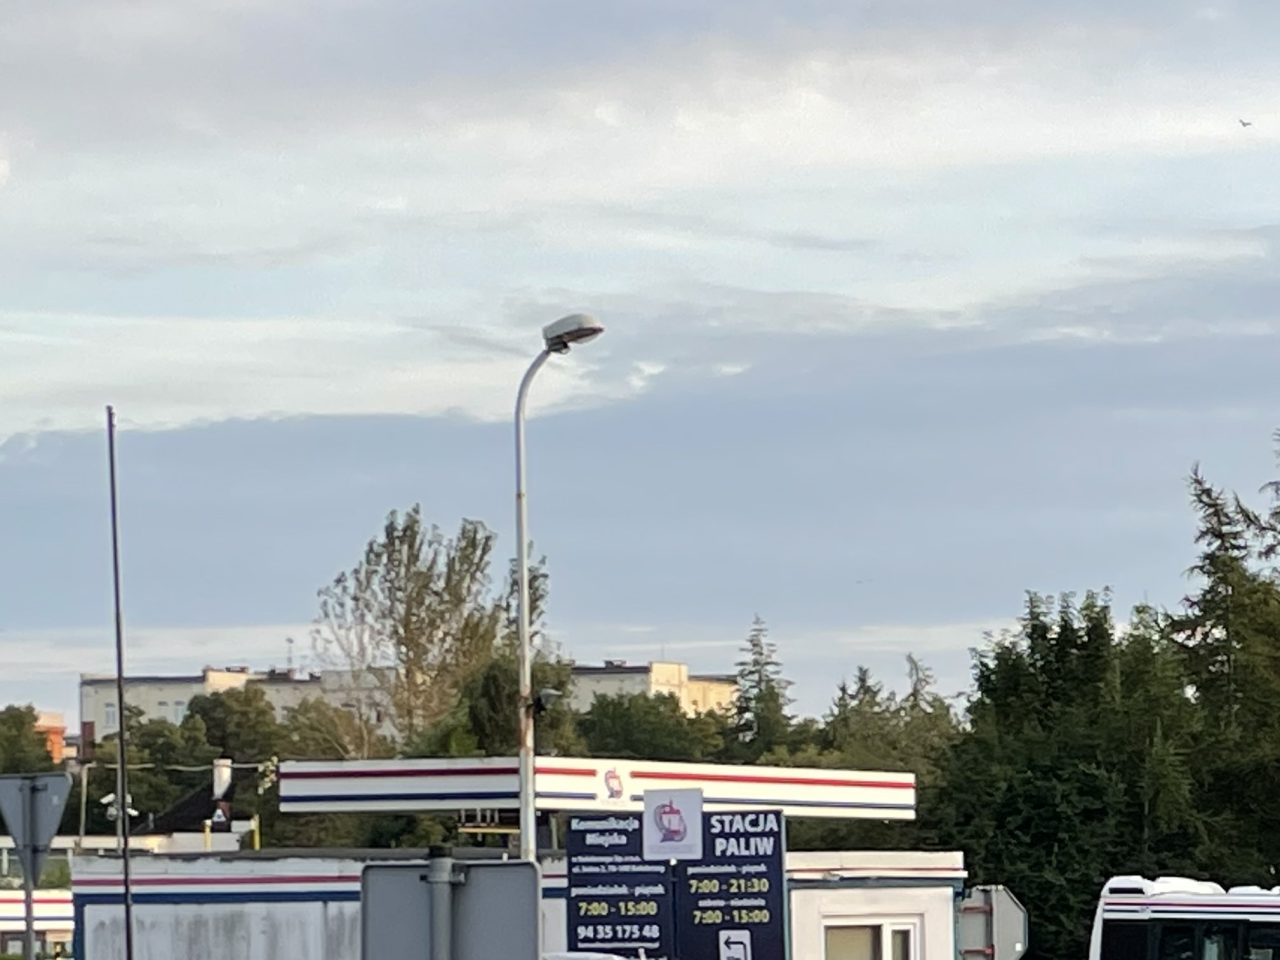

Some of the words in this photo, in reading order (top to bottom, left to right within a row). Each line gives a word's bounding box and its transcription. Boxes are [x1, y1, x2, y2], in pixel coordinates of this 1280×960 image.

[710, 814, 779, 833] STACJA
[715, 837, 775, 856] PALIW
[688, 879, 720, 894] 7:00
[729, 878, 770, 893] 21:30
[578, 901, 609, 916] 7:00
[618, 901, 658, 915] 15:00
[693, 910, 722, 924] 7:00
[732, 909, 770, 923] 15:00
[577, 925, 594, 939] 94
[596, 925, 613, 938] 35
[615, 925, 640, 938] 175
